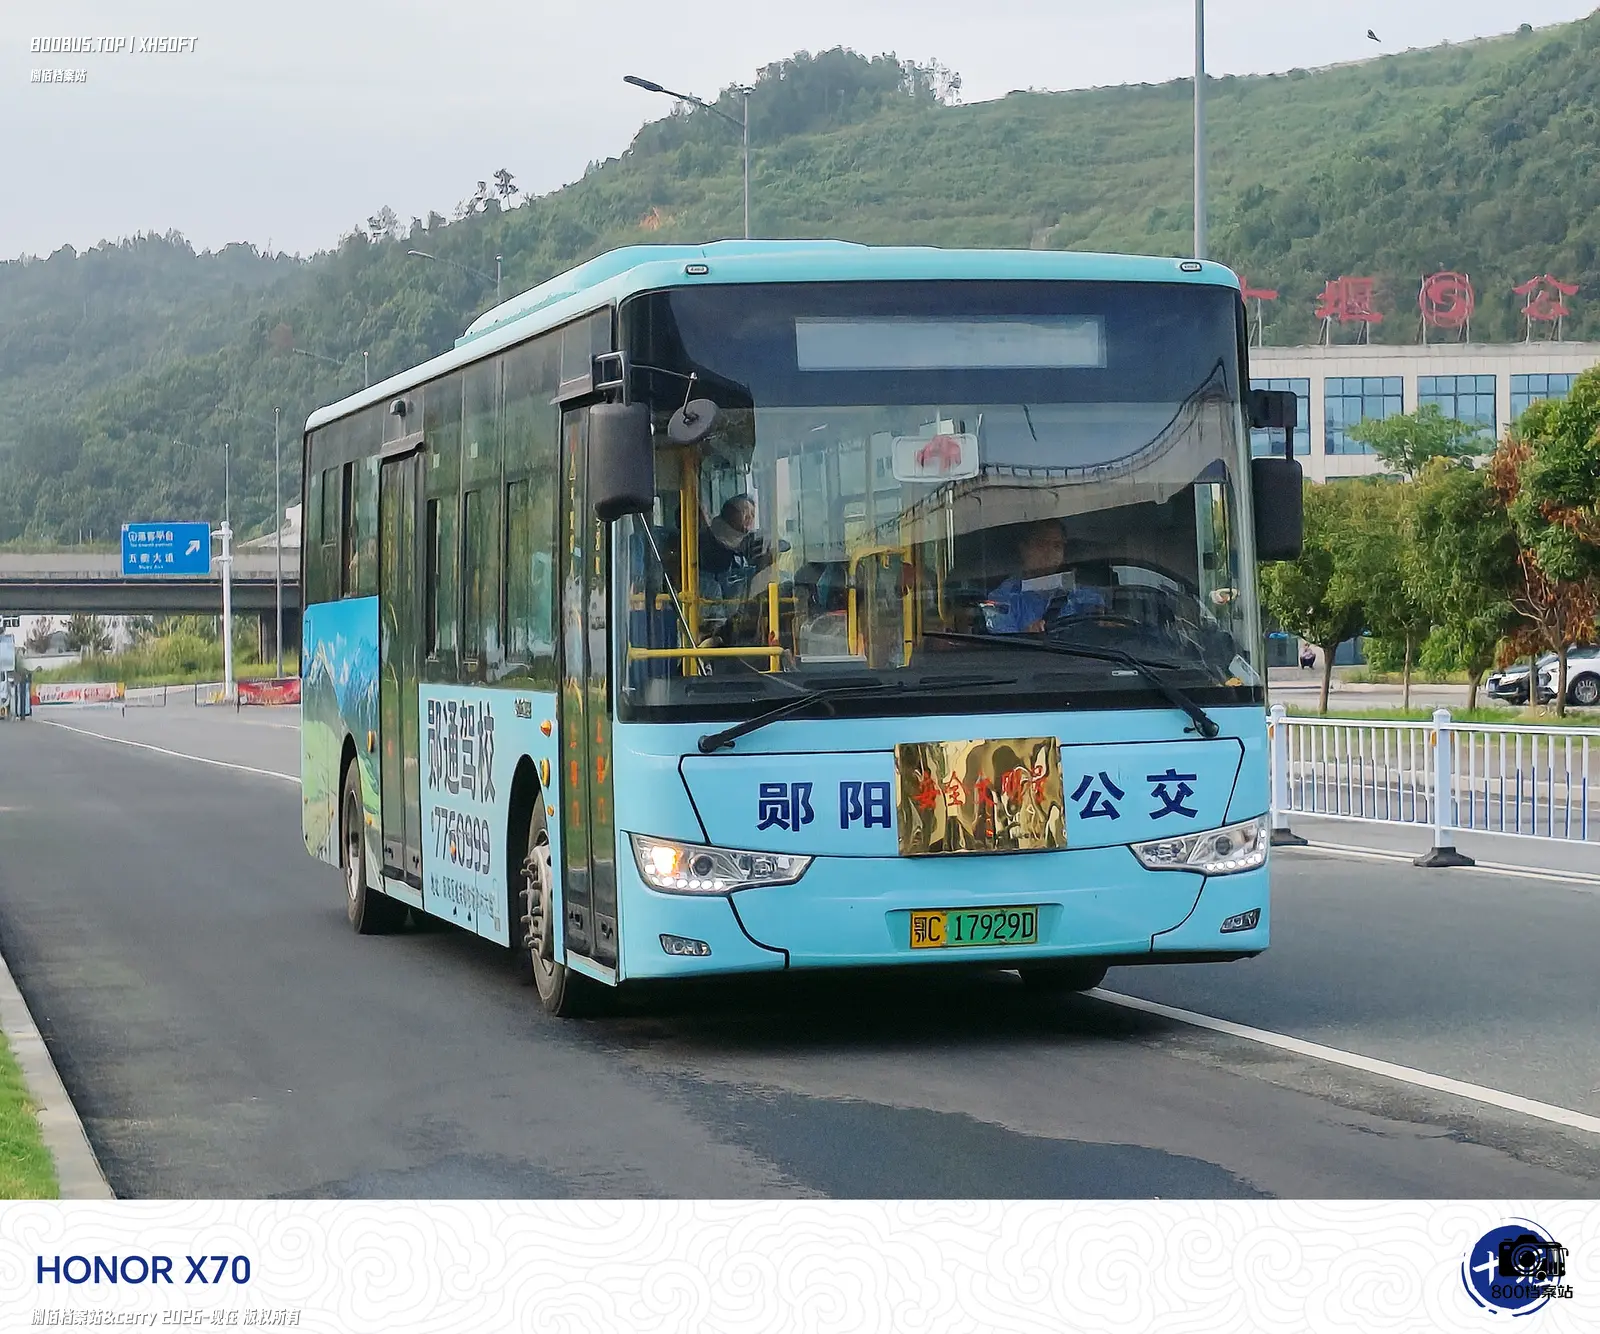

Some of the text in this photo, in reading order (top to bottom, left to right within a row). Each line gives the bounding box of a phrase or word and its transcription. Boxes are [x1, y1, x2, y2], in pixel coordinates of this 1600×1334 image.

[427, 699, 495, 804] 郧通驾校
[757, 768, 1198, 832] 郧阳 公交
